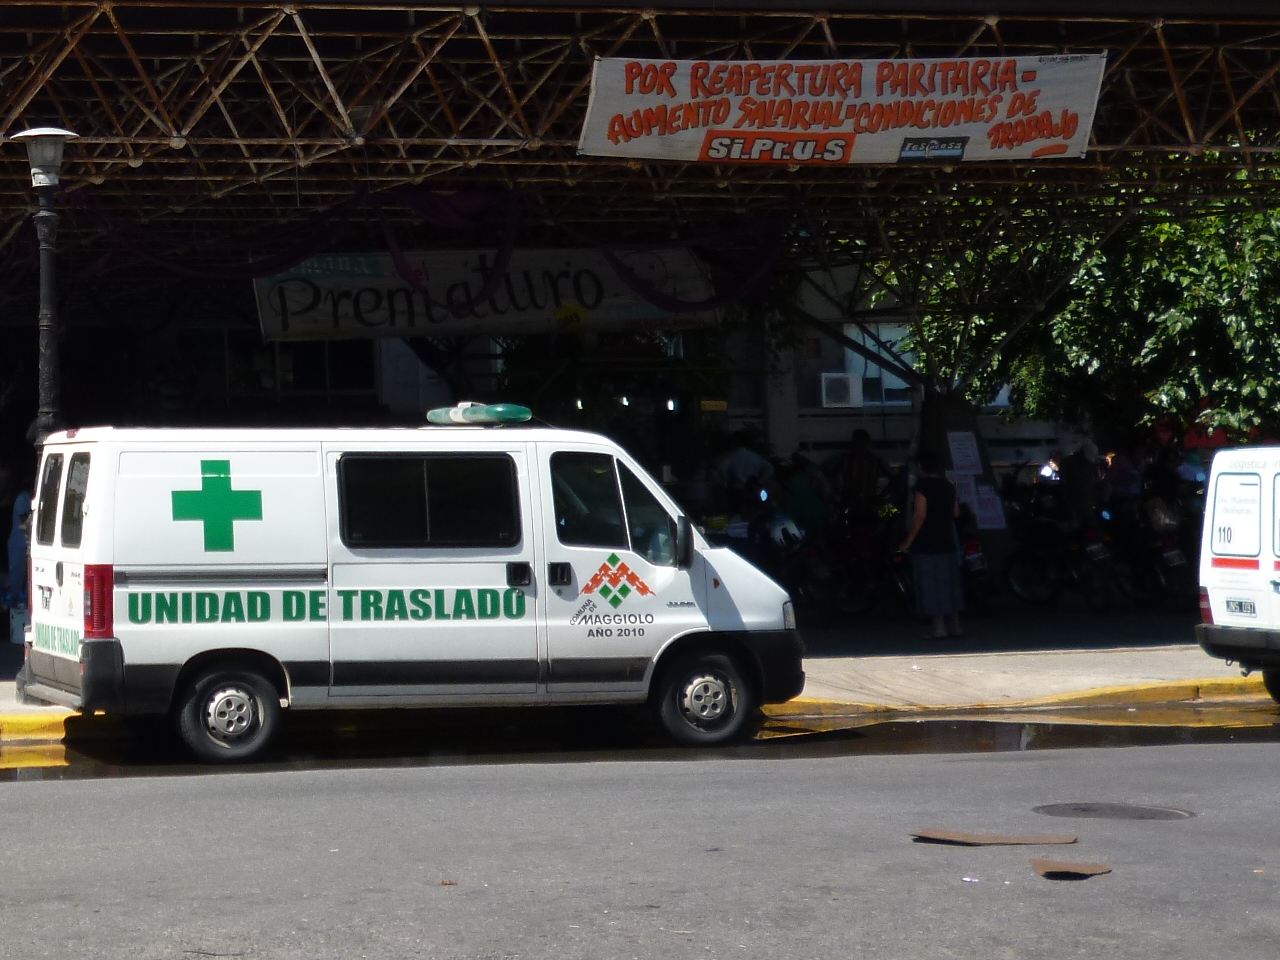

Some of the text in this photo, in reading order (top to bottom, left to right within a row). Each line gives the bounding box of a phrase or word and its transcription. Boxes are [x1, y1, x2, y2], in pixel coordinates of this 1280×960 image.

[624, 61, 677, 98] POR
[690, 61, 863, 100] REAPERTURA
[607, 97, 730, 145] AUMENTO
[1005, 89, 1041, 119] DE
[987, 109, 1079, 150] TRABAJO
[268, 253, 604, 331] Prematuro
[1218, 526, 1232, 544] 110
[128, 588, 526, 624] UNIDAD DE TRASLADO
[570, 598, 597, 626] COMUNA DE
[578, 613, 654, 625] MAGGIOLO
[587, 626, 645, 638] AÑO 2010
